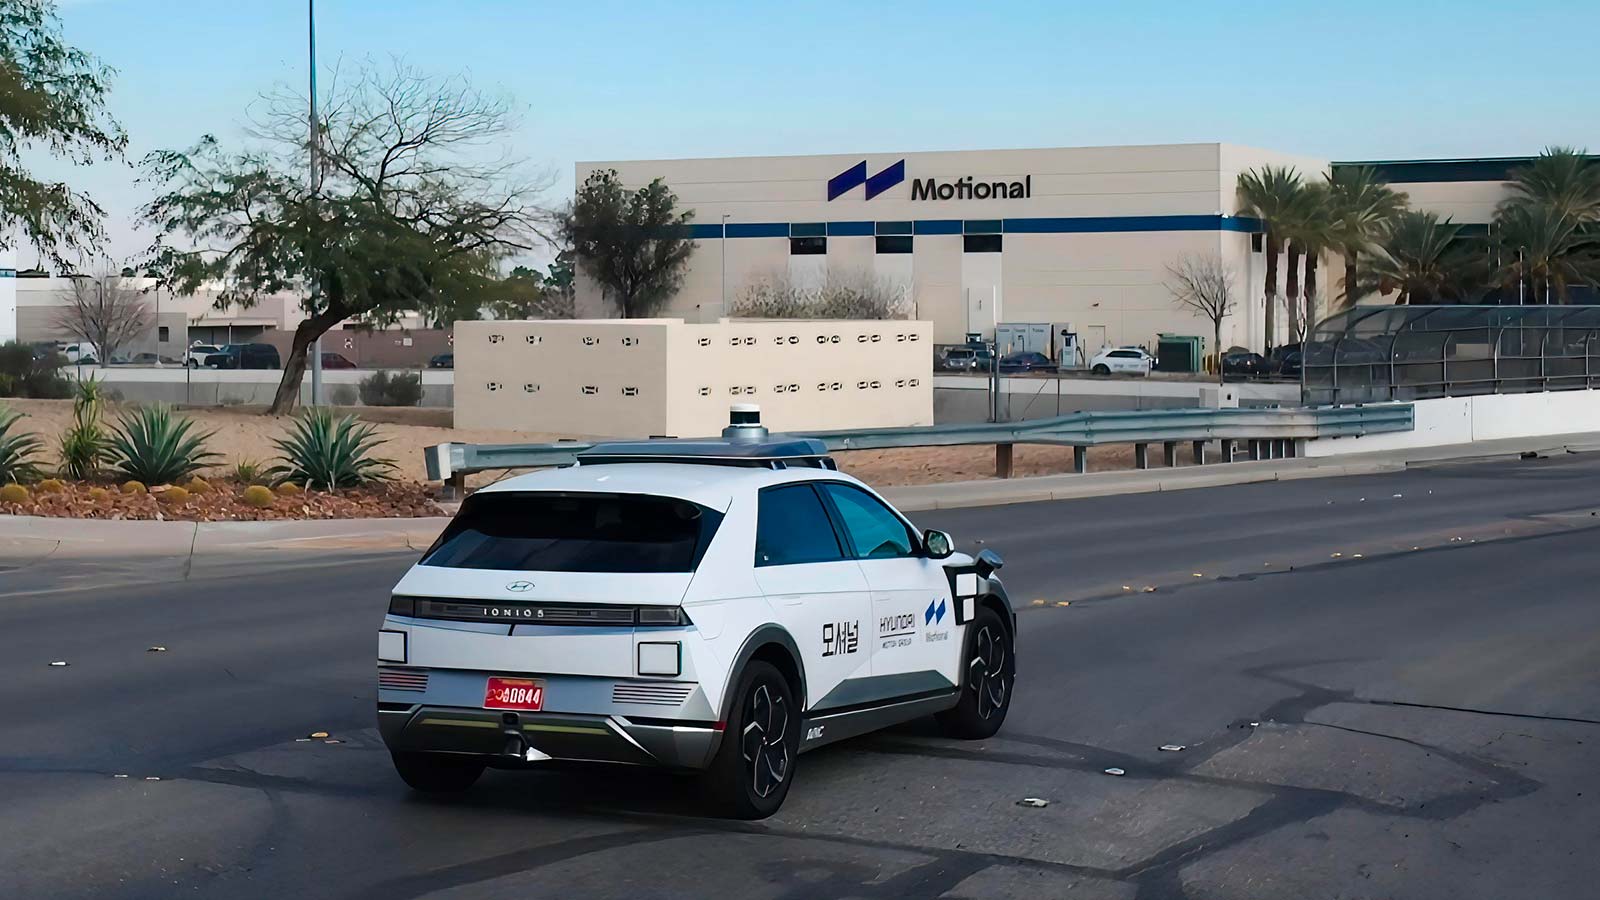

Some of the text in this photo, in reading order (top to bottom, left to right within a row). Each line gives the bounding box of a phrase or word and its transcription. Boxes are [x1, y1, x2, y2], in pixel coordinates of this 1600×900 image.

[911, 174, 1031, 201] Motional
[879, 613, 915, 632] HYUNDAI
[822, 619, 859, 657] 모서널
